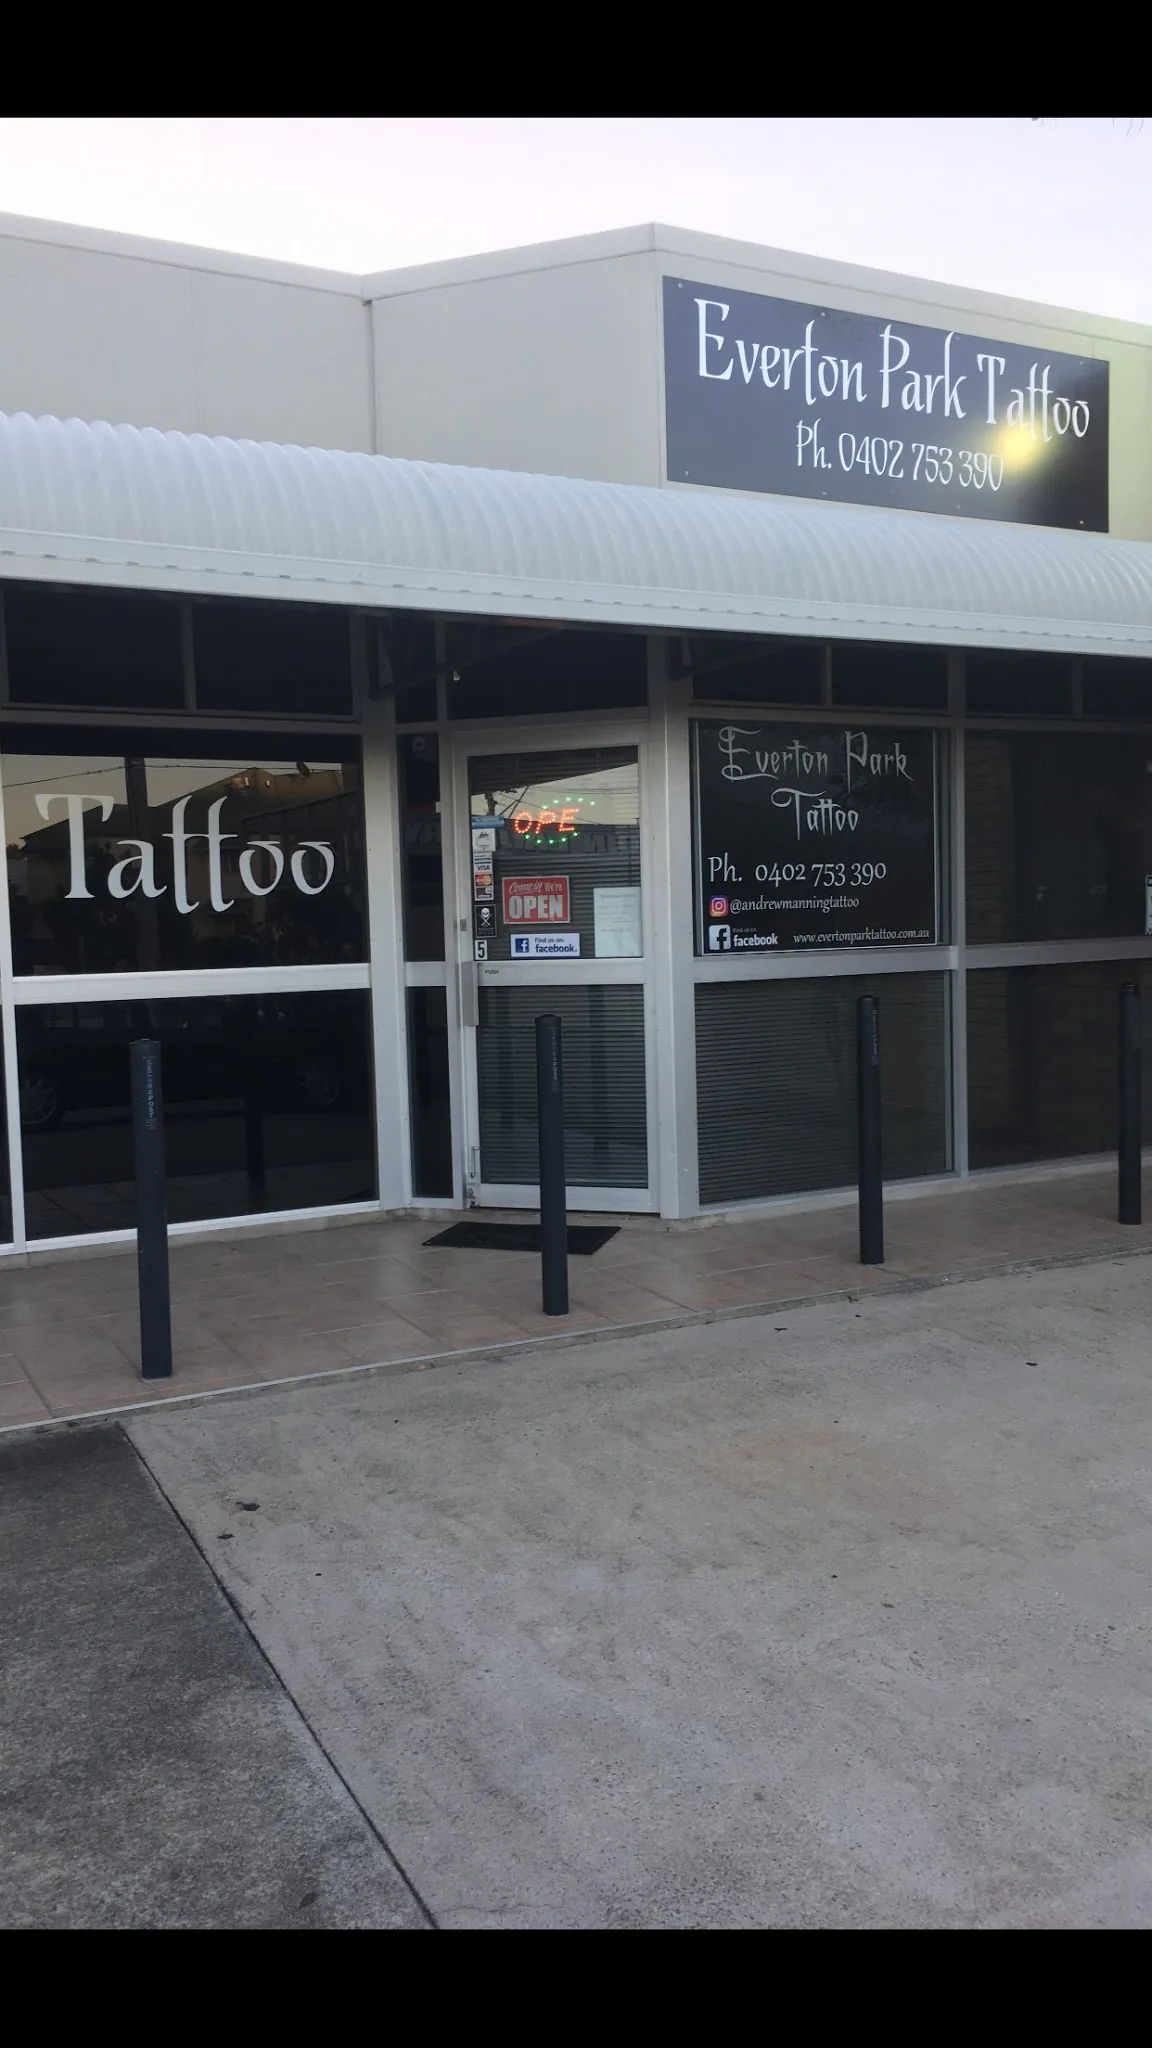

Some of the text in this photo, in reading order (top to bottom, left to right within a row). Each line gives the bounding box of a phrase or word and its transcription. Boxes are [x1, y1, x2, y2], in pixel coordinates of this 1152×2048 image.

[694, 298, 1090, 442] Everton Park Tattoo
[796, 418, 1004, 491] Ph. 0402 753 390
[718, 726, 914, 795] Everton Park
[770, 787, 859, 841] Tattoo
[35, 793, 336, 915] Tattoo
[707, 852, 887, 888] Ph. 0402 753 390
[509, 882, 533, 895] Come
[533, 881, 543, 893] in
[509, 895, 563, 919] OPEN
[730, 895, 860, 915] @andrewmanningtattoo
[477, 941, 485, 958] 5
[733, 933, 779, 947] facebook
[793, 927, 930, 944] www.evertonparktattoo.com.au
